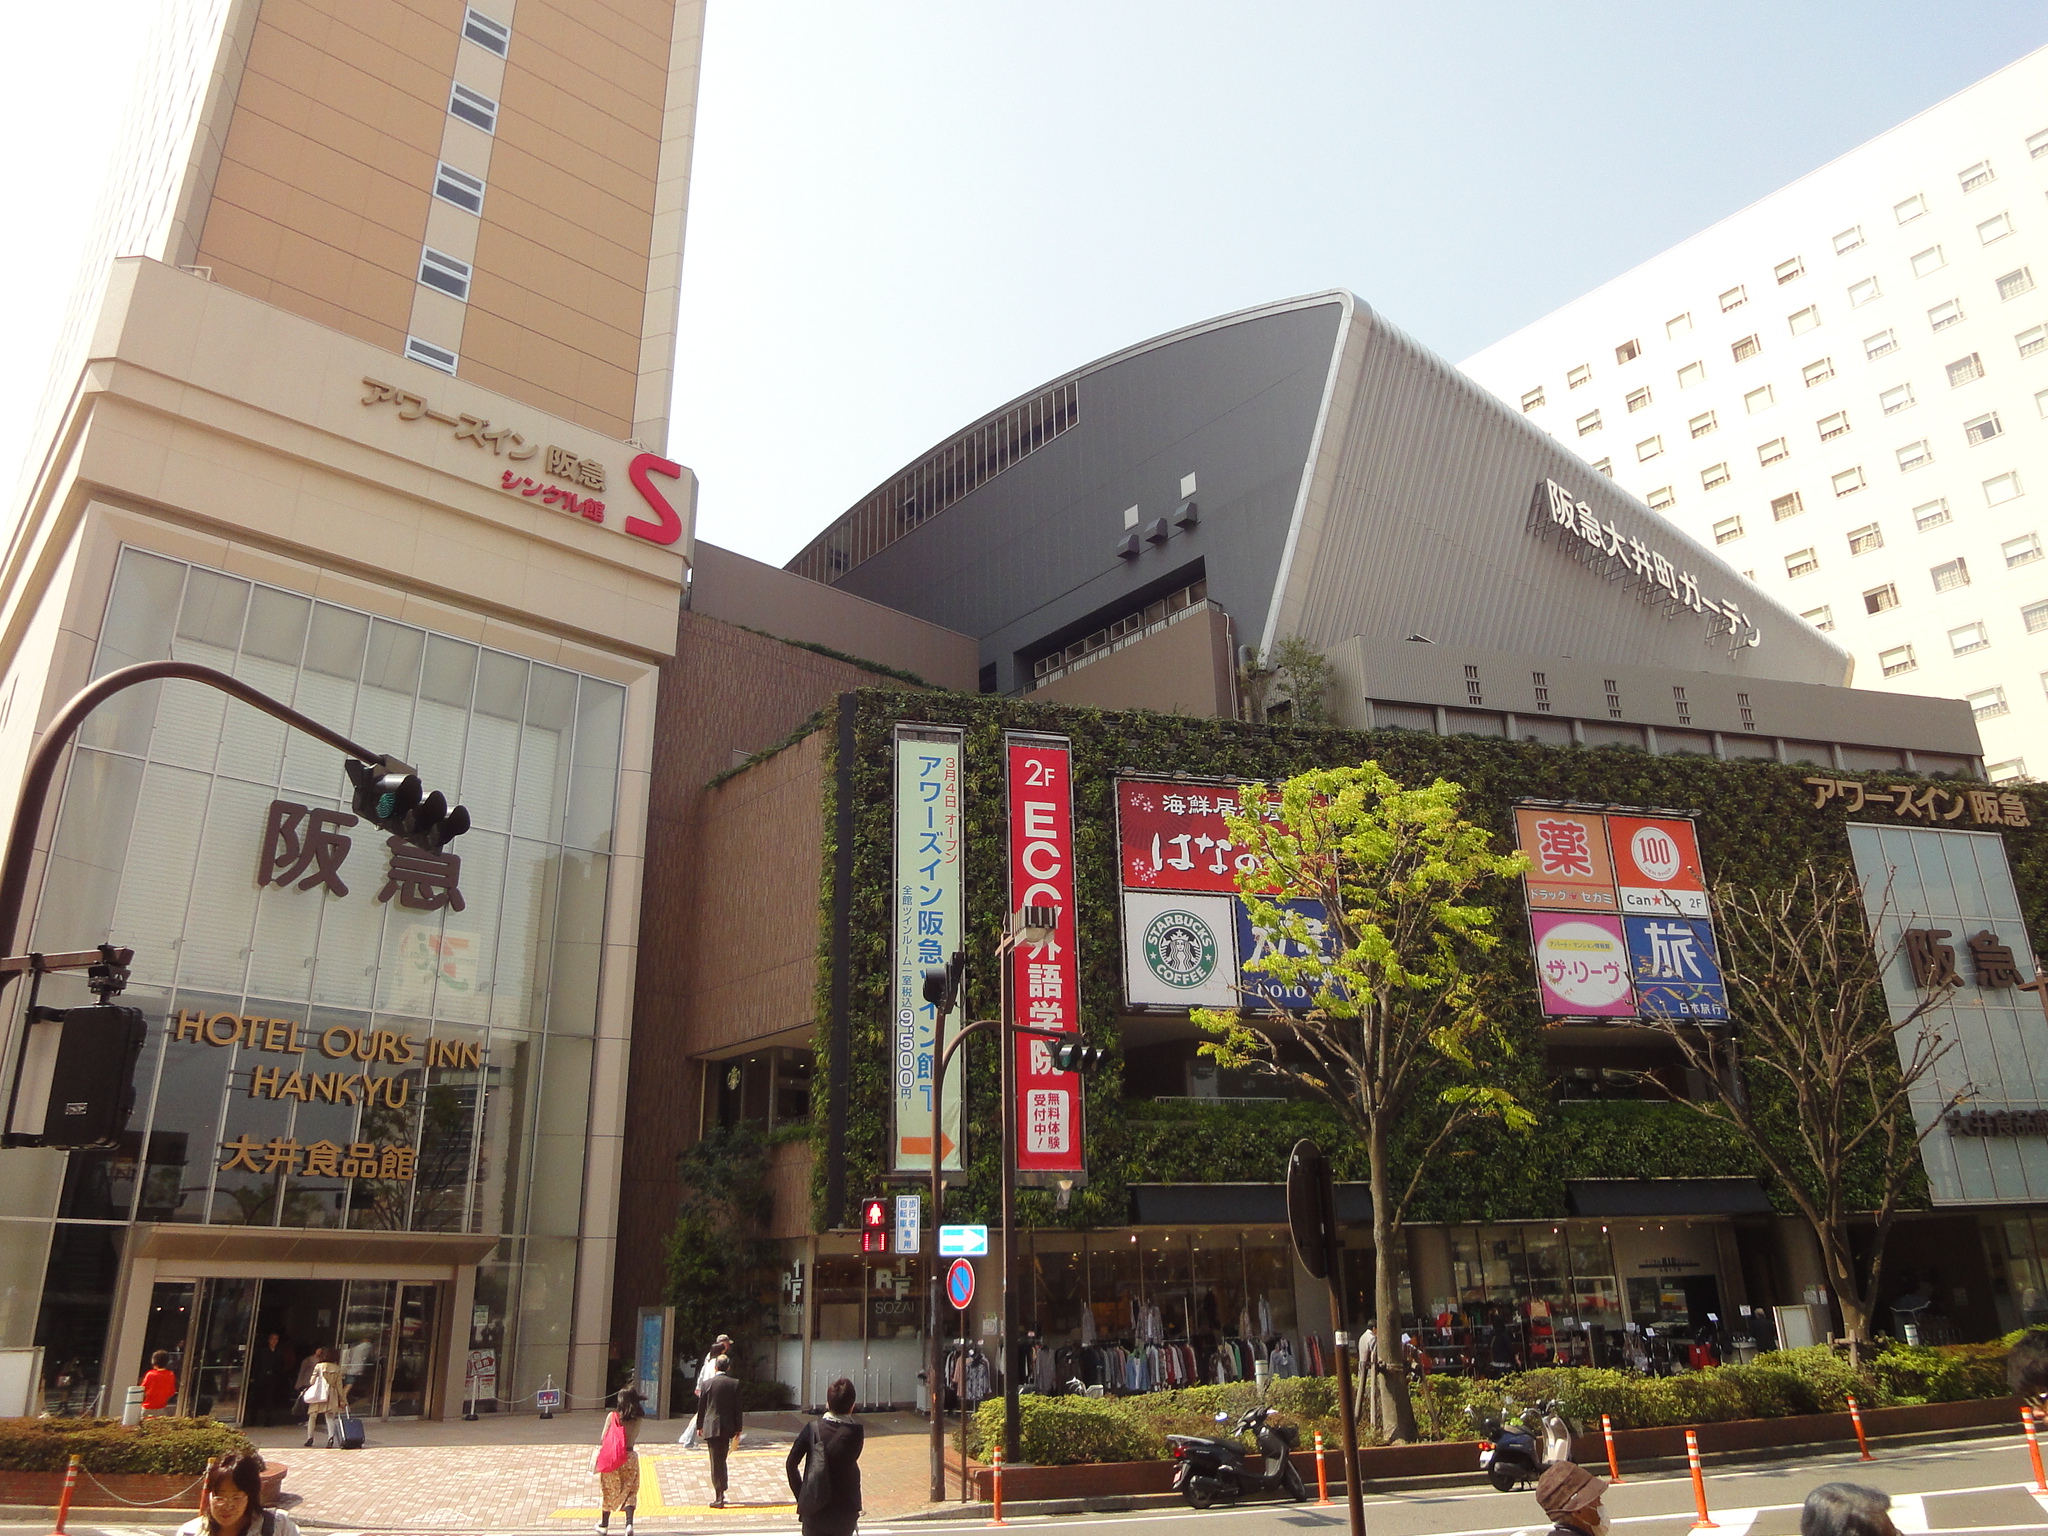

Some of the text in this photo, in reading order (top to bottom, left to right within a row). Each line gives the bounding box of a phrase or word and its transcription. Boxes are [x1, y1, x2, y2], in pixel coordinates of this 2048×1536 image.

[362, 376, 608, 492] アワーズイン 阪急
[501, 470, 606, 523] シングル館
[625, 453, 683, 545] S
[1547, 478, 1761, 648] 阪急大井町ガーデン
[1025, 759, 1055, 787] 2F
[1162, 793, 1284, 822] 海鮮居屋
[1806, 777, 2031, 828] アワーズイン 阪急
[257, 800, 466, 912] 阪急
[1537, 820, 1593, 876] 薬
[1638, 837, 1671, 865] 100
[917, 756, 944, 1080] アワーズイン阪急イン館
[1531, 888, 1613, 904] ドラッグ セガミ
[1147, 914, 1213, 948] STARBUCKS
[1644, 923, 1702, 979] 旅
[1156, 964, 1207, 985] COFFEE
[1906, 929, 2024, 988] 阪急
[1680, 1002, 1721, 1015] 日本旅行
[176, 1009, 483, 1070] HOTEL OURS INN
[252, 1065, 410, 1109] HANKYU
[1048, 1093, 1060, 1149] 無料体験
[220, 1134, 418, 1181] 大井食品館
[899, 1199, 907, 1227] 自転車
[908, 1199, 916, 1227] 歩行者
[903, 1229, 912, 1249] 専用
[875, 1302, 915, 1314] SOZAI
